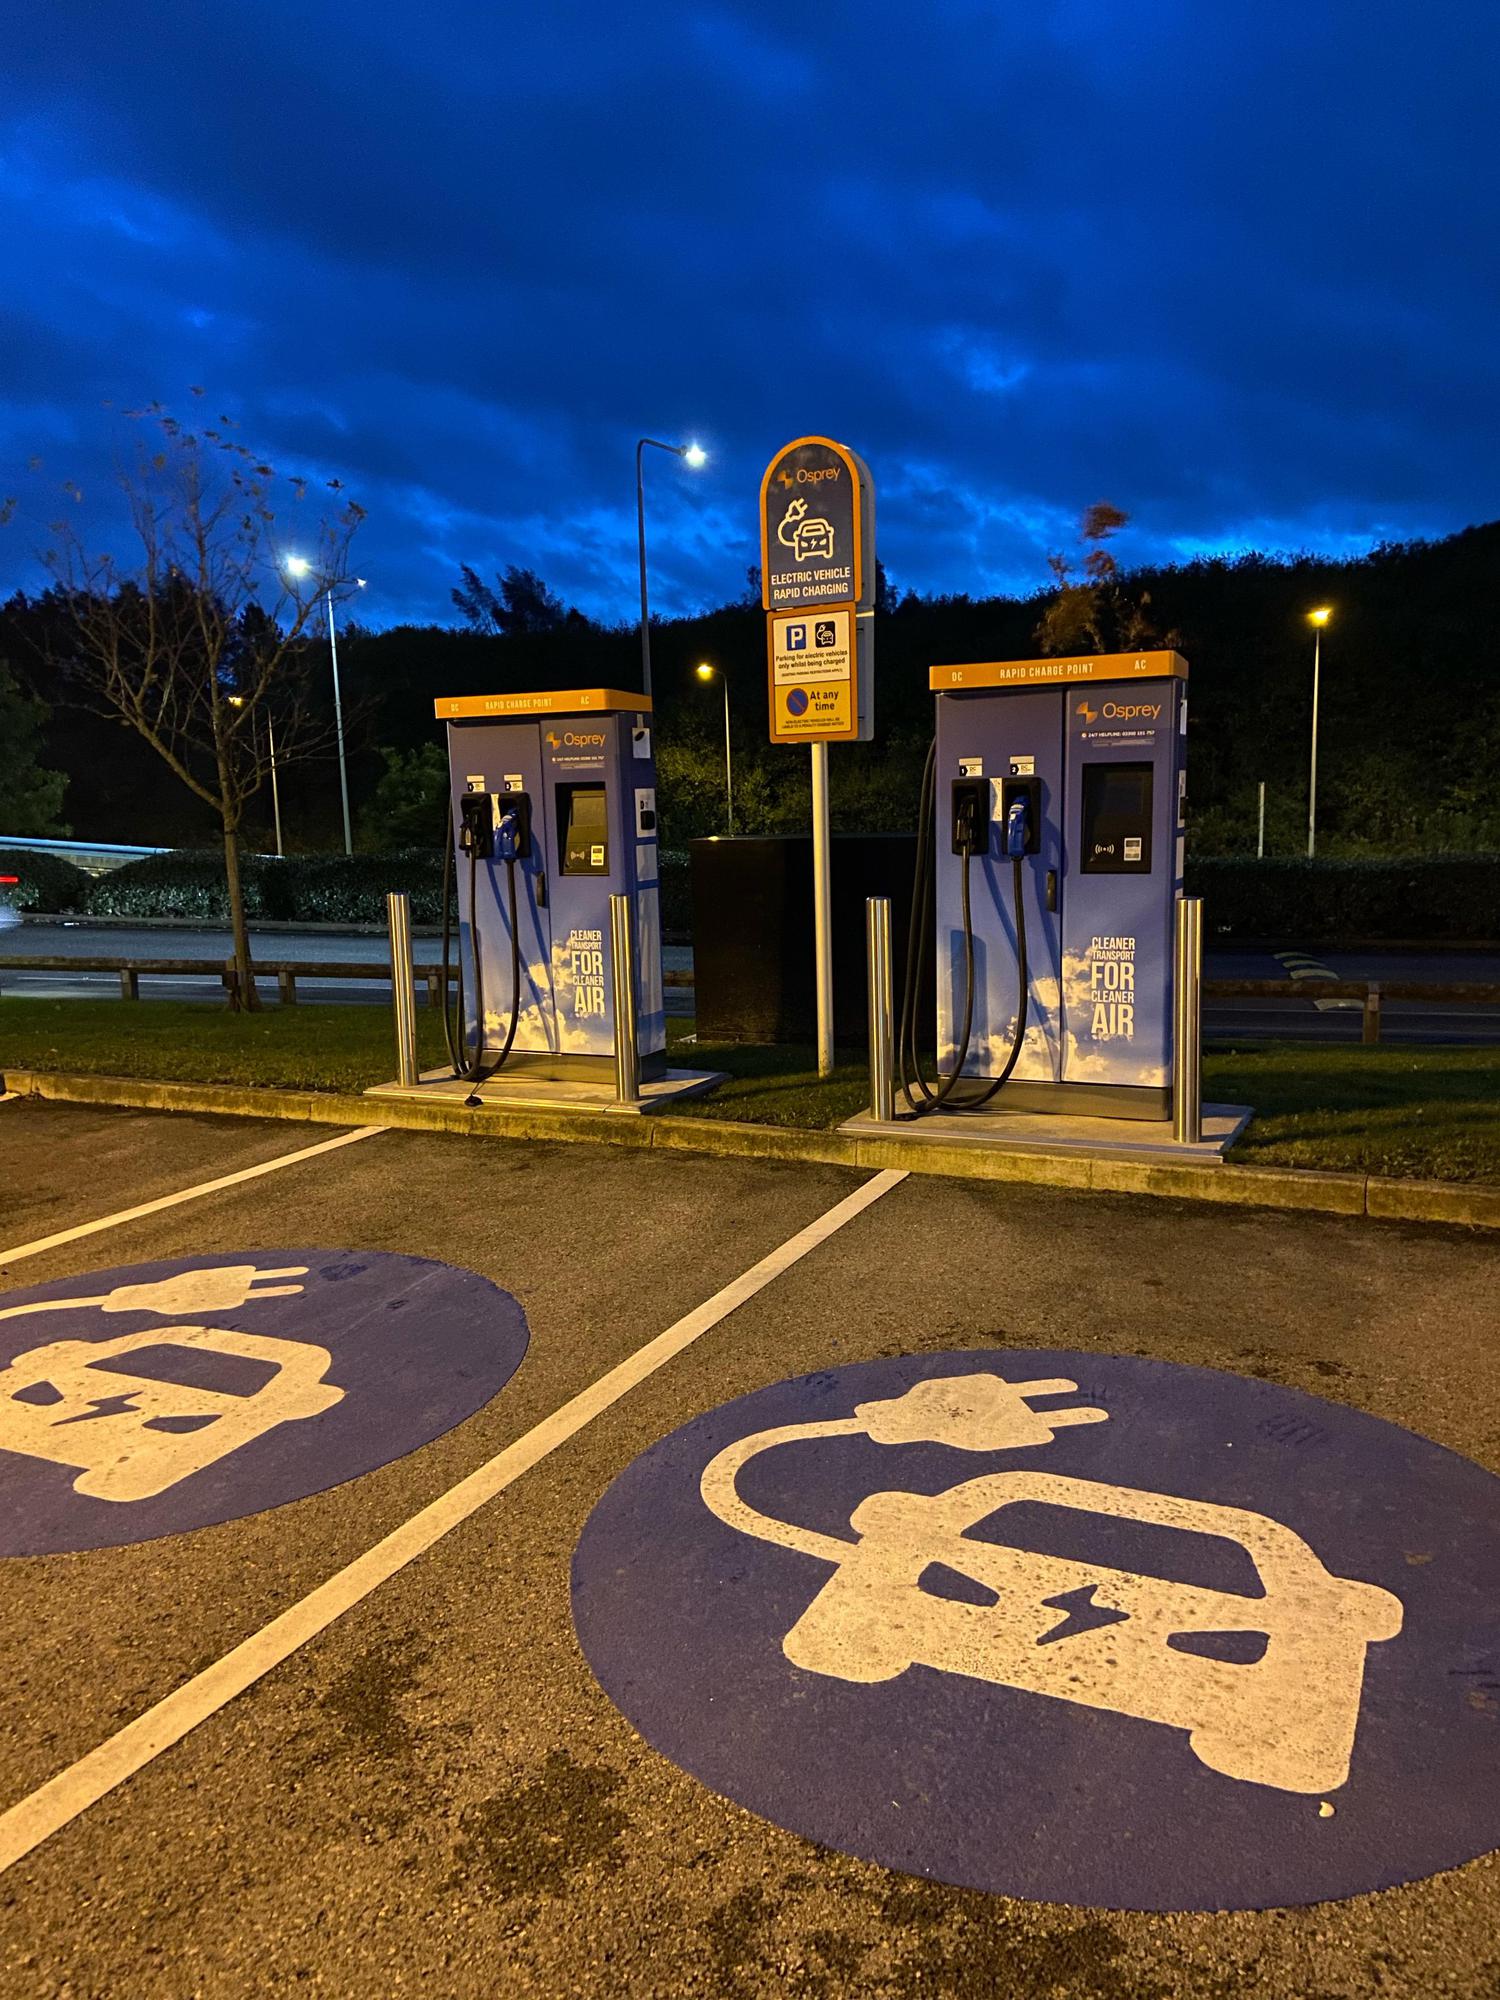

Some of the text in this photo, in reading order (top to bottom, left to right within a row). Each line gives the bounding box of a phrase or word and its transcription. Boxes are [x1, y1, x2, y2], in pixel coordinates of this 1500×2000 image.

[796, 467, 841, 485] Osprey
[771, 567, 850, 585] ELECTRIC VEHICLE
[773, 582, 848, 600] RAPID CHARGING
[790, 628, 803, 648] P
[805, 651, 825, 659] electric
[823, 657, 845, 665] charged
[1000, 667, 1026, 679] RAPID
[1029, 665, 1063, 677] CHARGE
[1067, 663, 1094, 675] POINT
[1134, 659, 1147, 670] AC
[485, 701, 504, 710] RAPID
[533, 698, 552, 708] POINT
[580, 696, 590, 705] AC
[810, 691, 839, 700] At any
[815, 702, 835, 711] time
[1102, 702, 1161, 721] Osprey
[564, 732, 606, 748] Osprey
[570, 930, 602, 941] CLEANER
[1091, 936, 1135, 950] CLEANER
[571, 941, 602, 950] TRANSPORT
[571, 950, 603, 975] FOR
[1092, 950, 1135, 961] TRANSPORT
[572, 975, 604, 986] CLEANER
[1091, 961, 1135, 990] FOR
[574, 985, 605, 1014] AIR
[1091, 990, 1135, 1003] CLEANER
[1091, 1003, 1134, 1035] AIR
